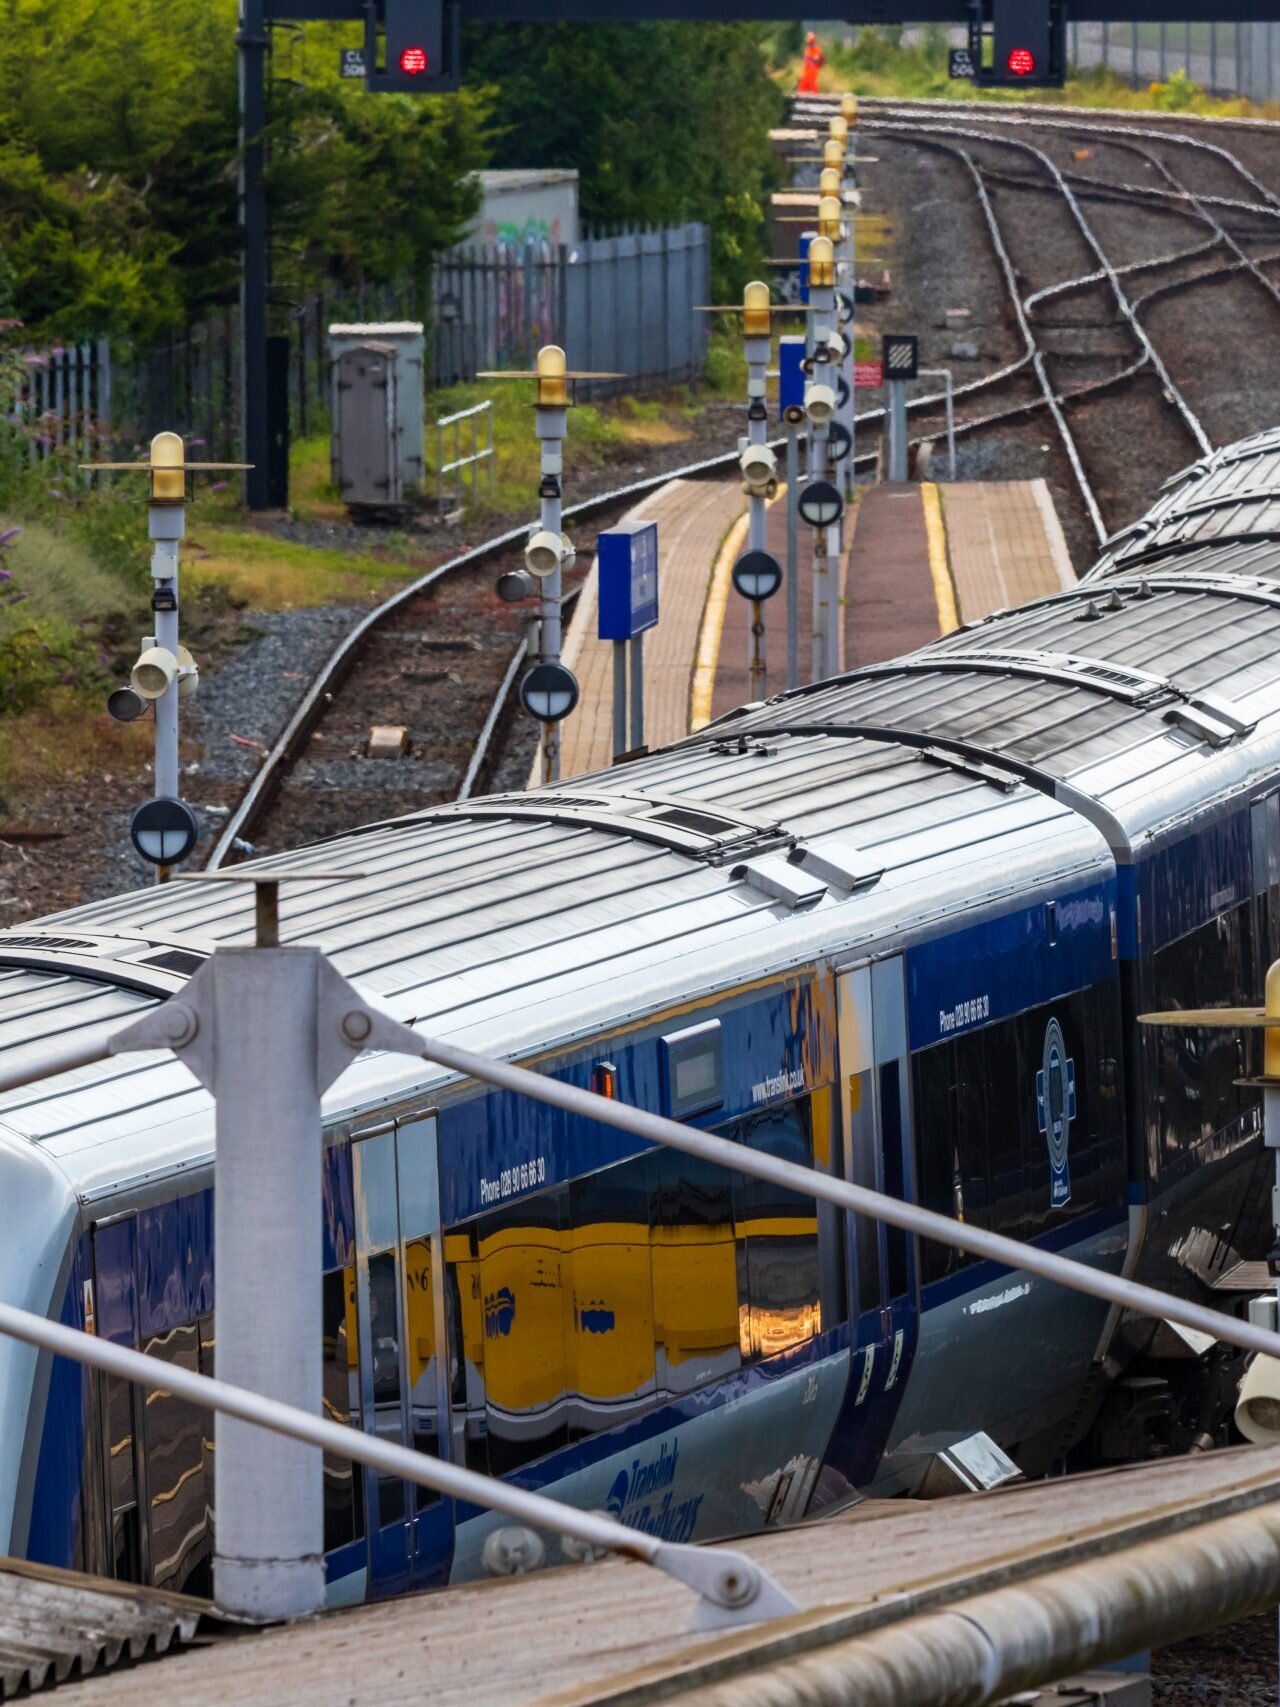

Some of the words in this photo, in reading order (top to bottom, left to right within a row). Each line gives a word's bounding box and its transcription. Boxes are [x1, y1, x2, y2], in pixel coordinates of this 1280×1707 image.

[346, 50, 363, 63] CL
[480, 1177, 500, 1205] Phone
[500, 1169, 511, 1197] 028
[512, 1166, 520, 1193] 90
[520, 1163, 528, 1190] 66
[528, 1159, 536, 1187] 66
[537, 1156, 545, 1183] 30
[626, 1437, 679, 1505] Translink
